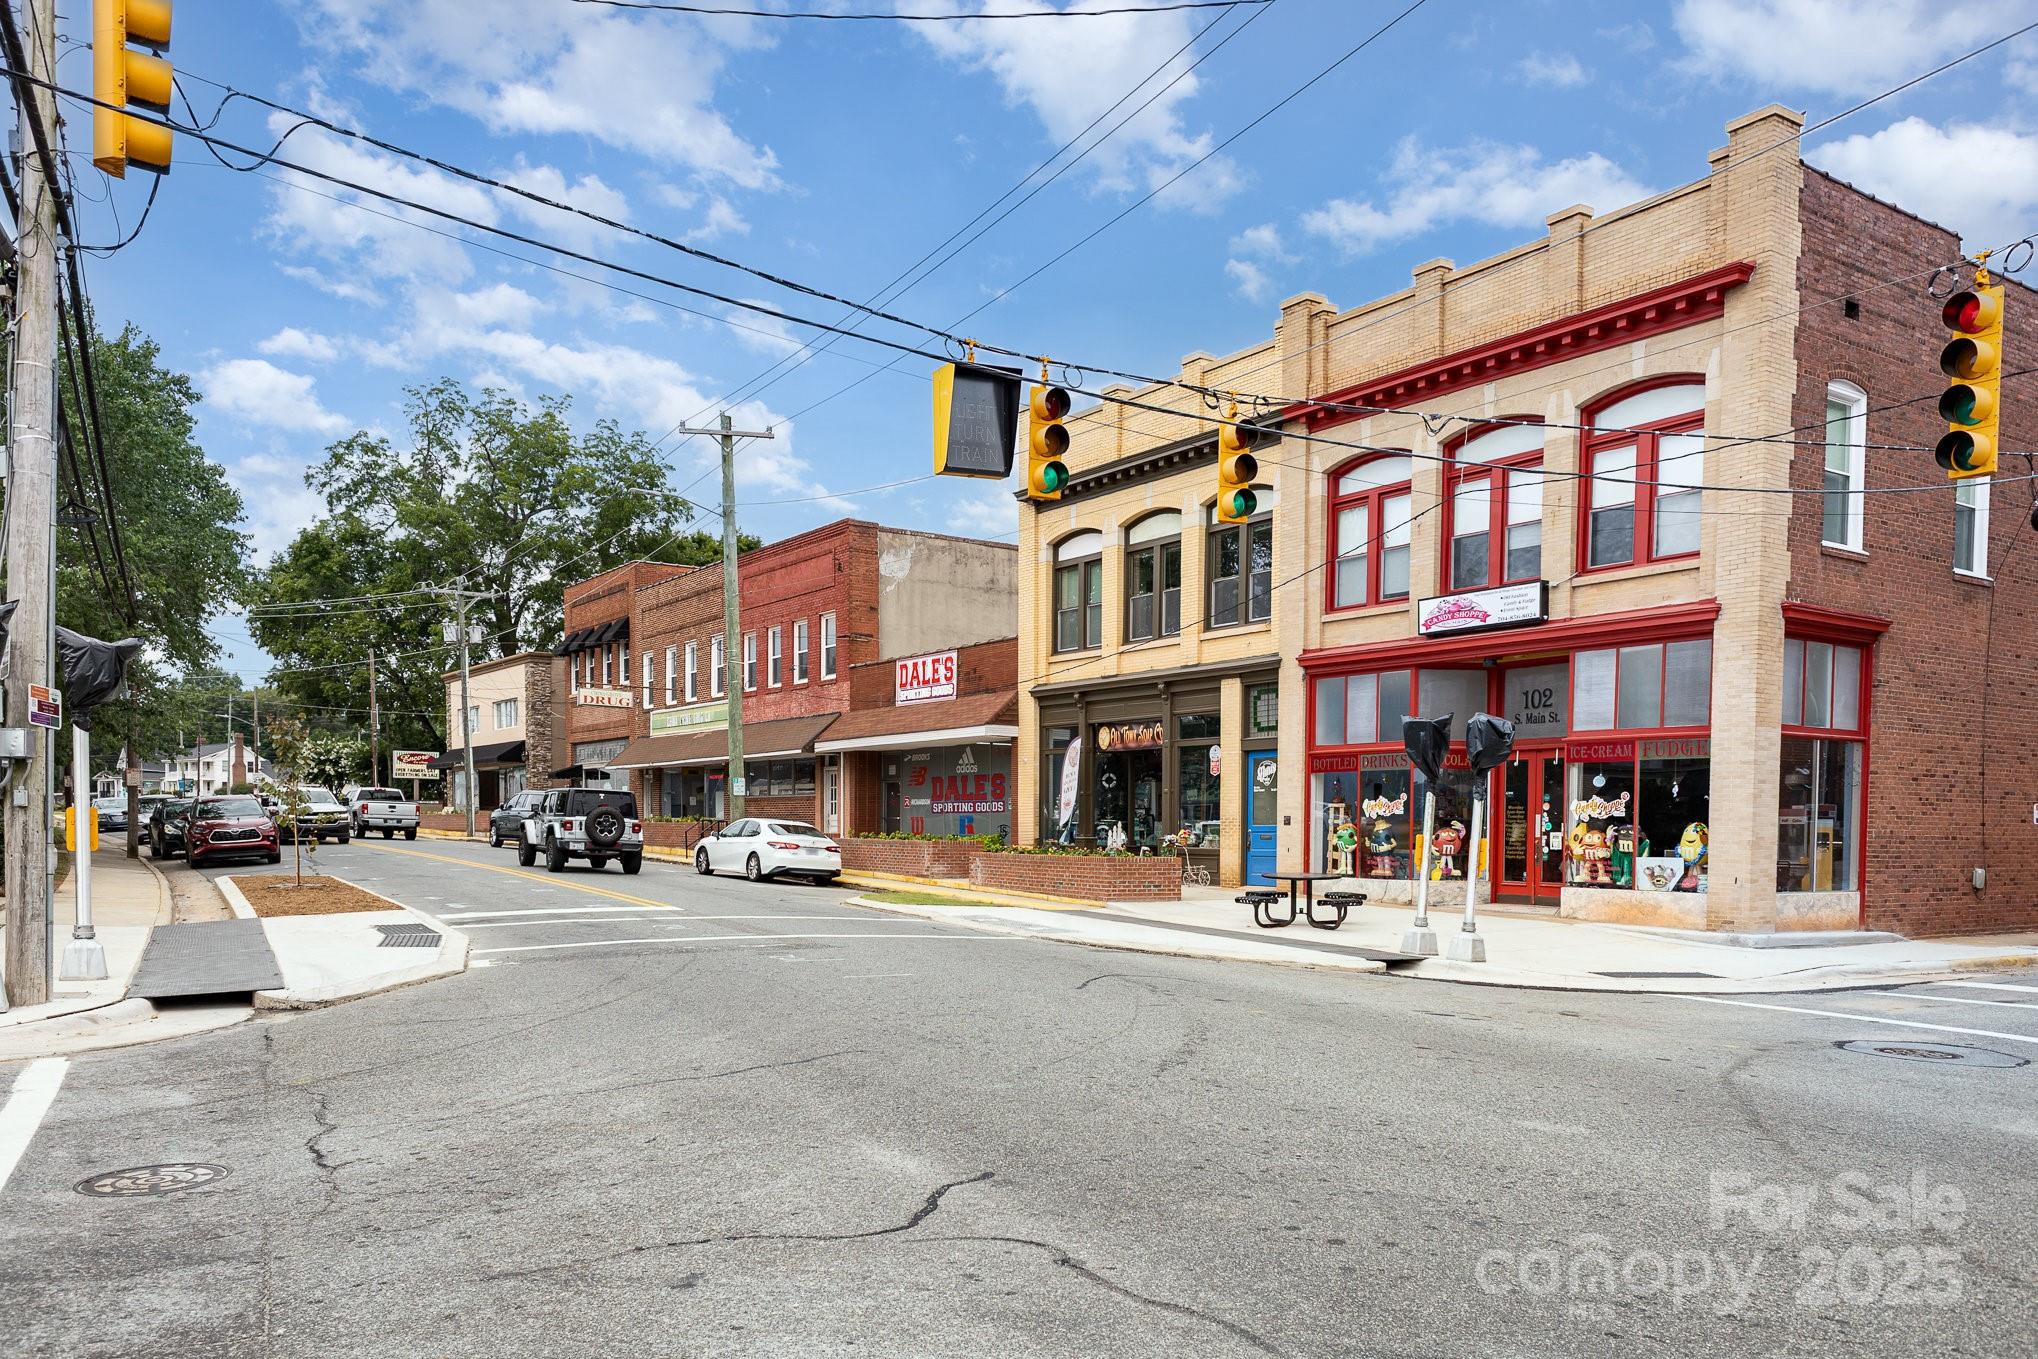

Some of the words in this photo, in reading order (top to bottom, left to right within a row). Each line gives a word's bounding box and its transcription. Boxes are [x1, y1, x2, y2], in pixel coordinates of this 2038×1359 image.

[954, 423, 997, 442] TURN
[952, 445, 1000, 463] TRAIN
[1427, 613, 1453, 625] CANDY
[1454, 610, 1485, 619] SHOPPE
[899, 656, 954, 688] DALE'S
[583, 695, 630, 707] DRUG
[1522, 688, 1554, 710] 102
[1514, 713, 1523, 725] S.
[1525, 712, 1546, 725] Main
[1548, 711, 1561, 723] St.
[1569, 744, 1633, 759] ICE-CREAM
[1643, 740, 1708, 758] FUDGE
[400, 754, 430, 763] Encore
[1313, 756, 1357, 770] BOTTLED
[1361, 753, 1408, 768] DRINKS
[1444, 754, 1471, 767] COLA
[956, 764, 978, 773] adidas
[931, 773, 1006, 802] DALE'S
[932, 802, 974, 813] SPORTING
[975, 801, 1004, 812] GOODS
